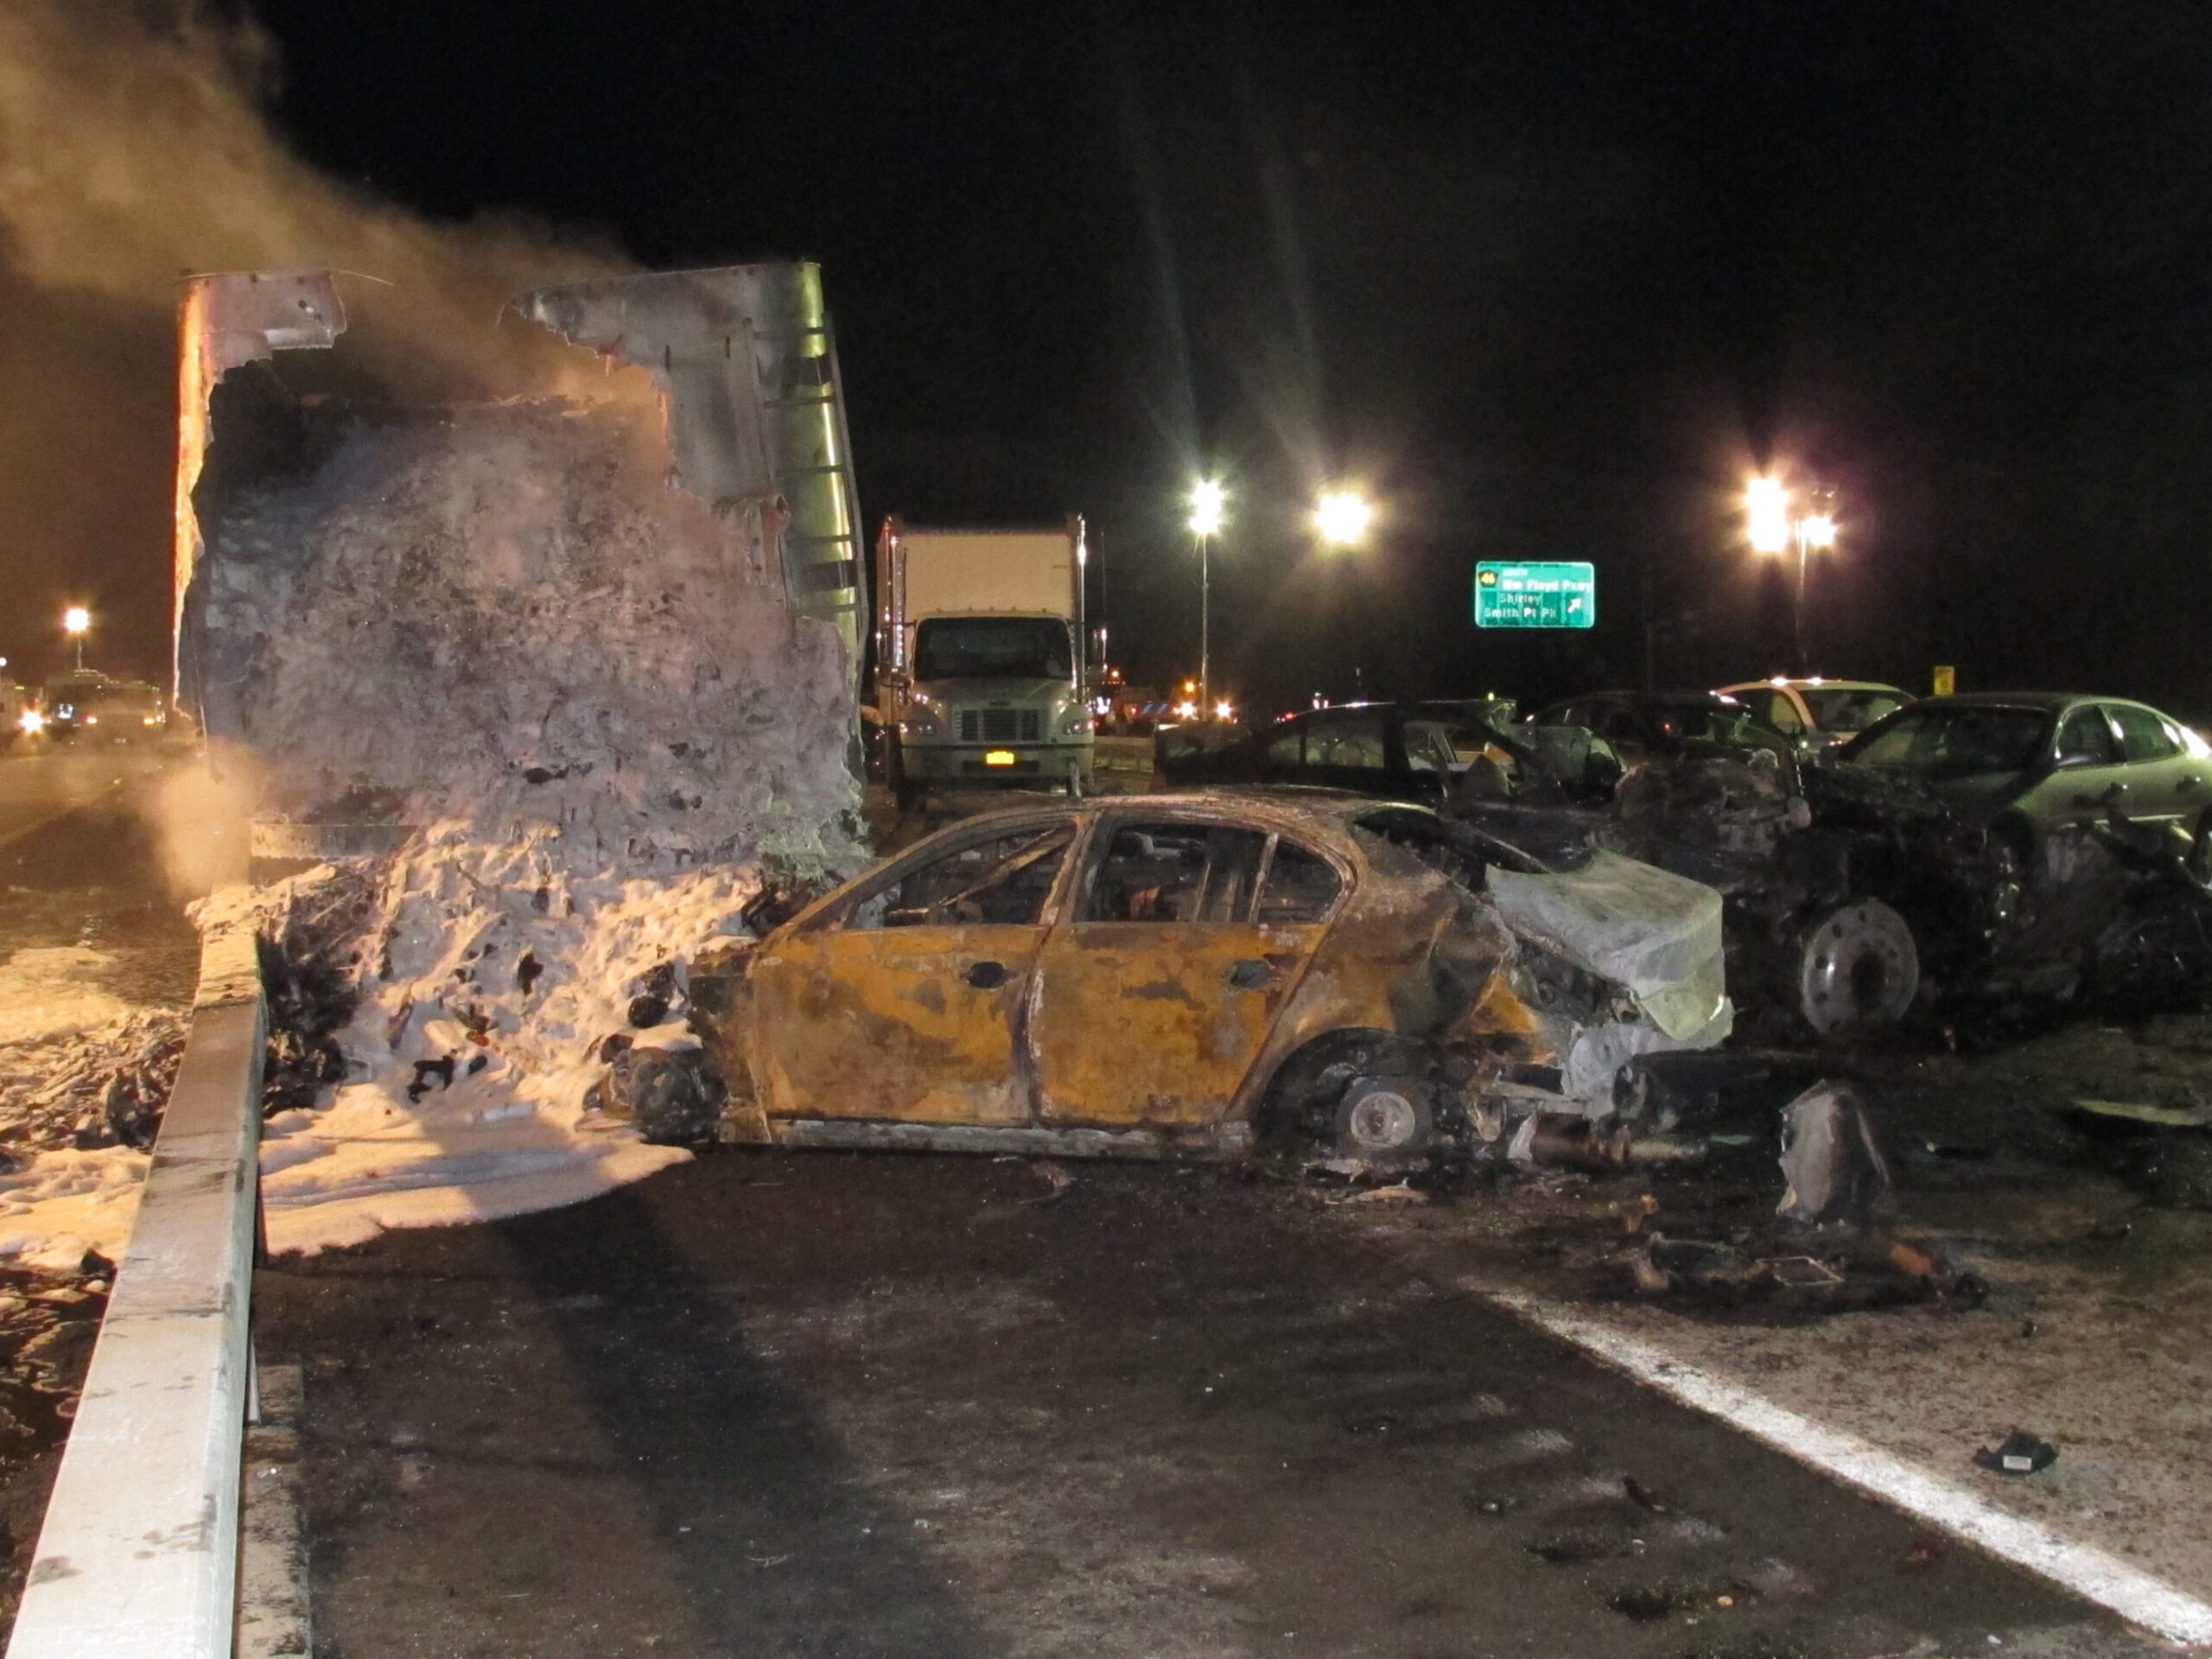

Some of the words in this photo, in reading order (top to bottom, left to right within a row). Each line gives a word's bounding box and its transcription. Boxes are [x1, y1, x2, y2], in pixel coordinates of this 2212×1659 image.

[1499, 593, 1541, 606] Shirley
[1484, 607, 1519, 618] Smith
[1523, 607, 1536, 618] Pt
